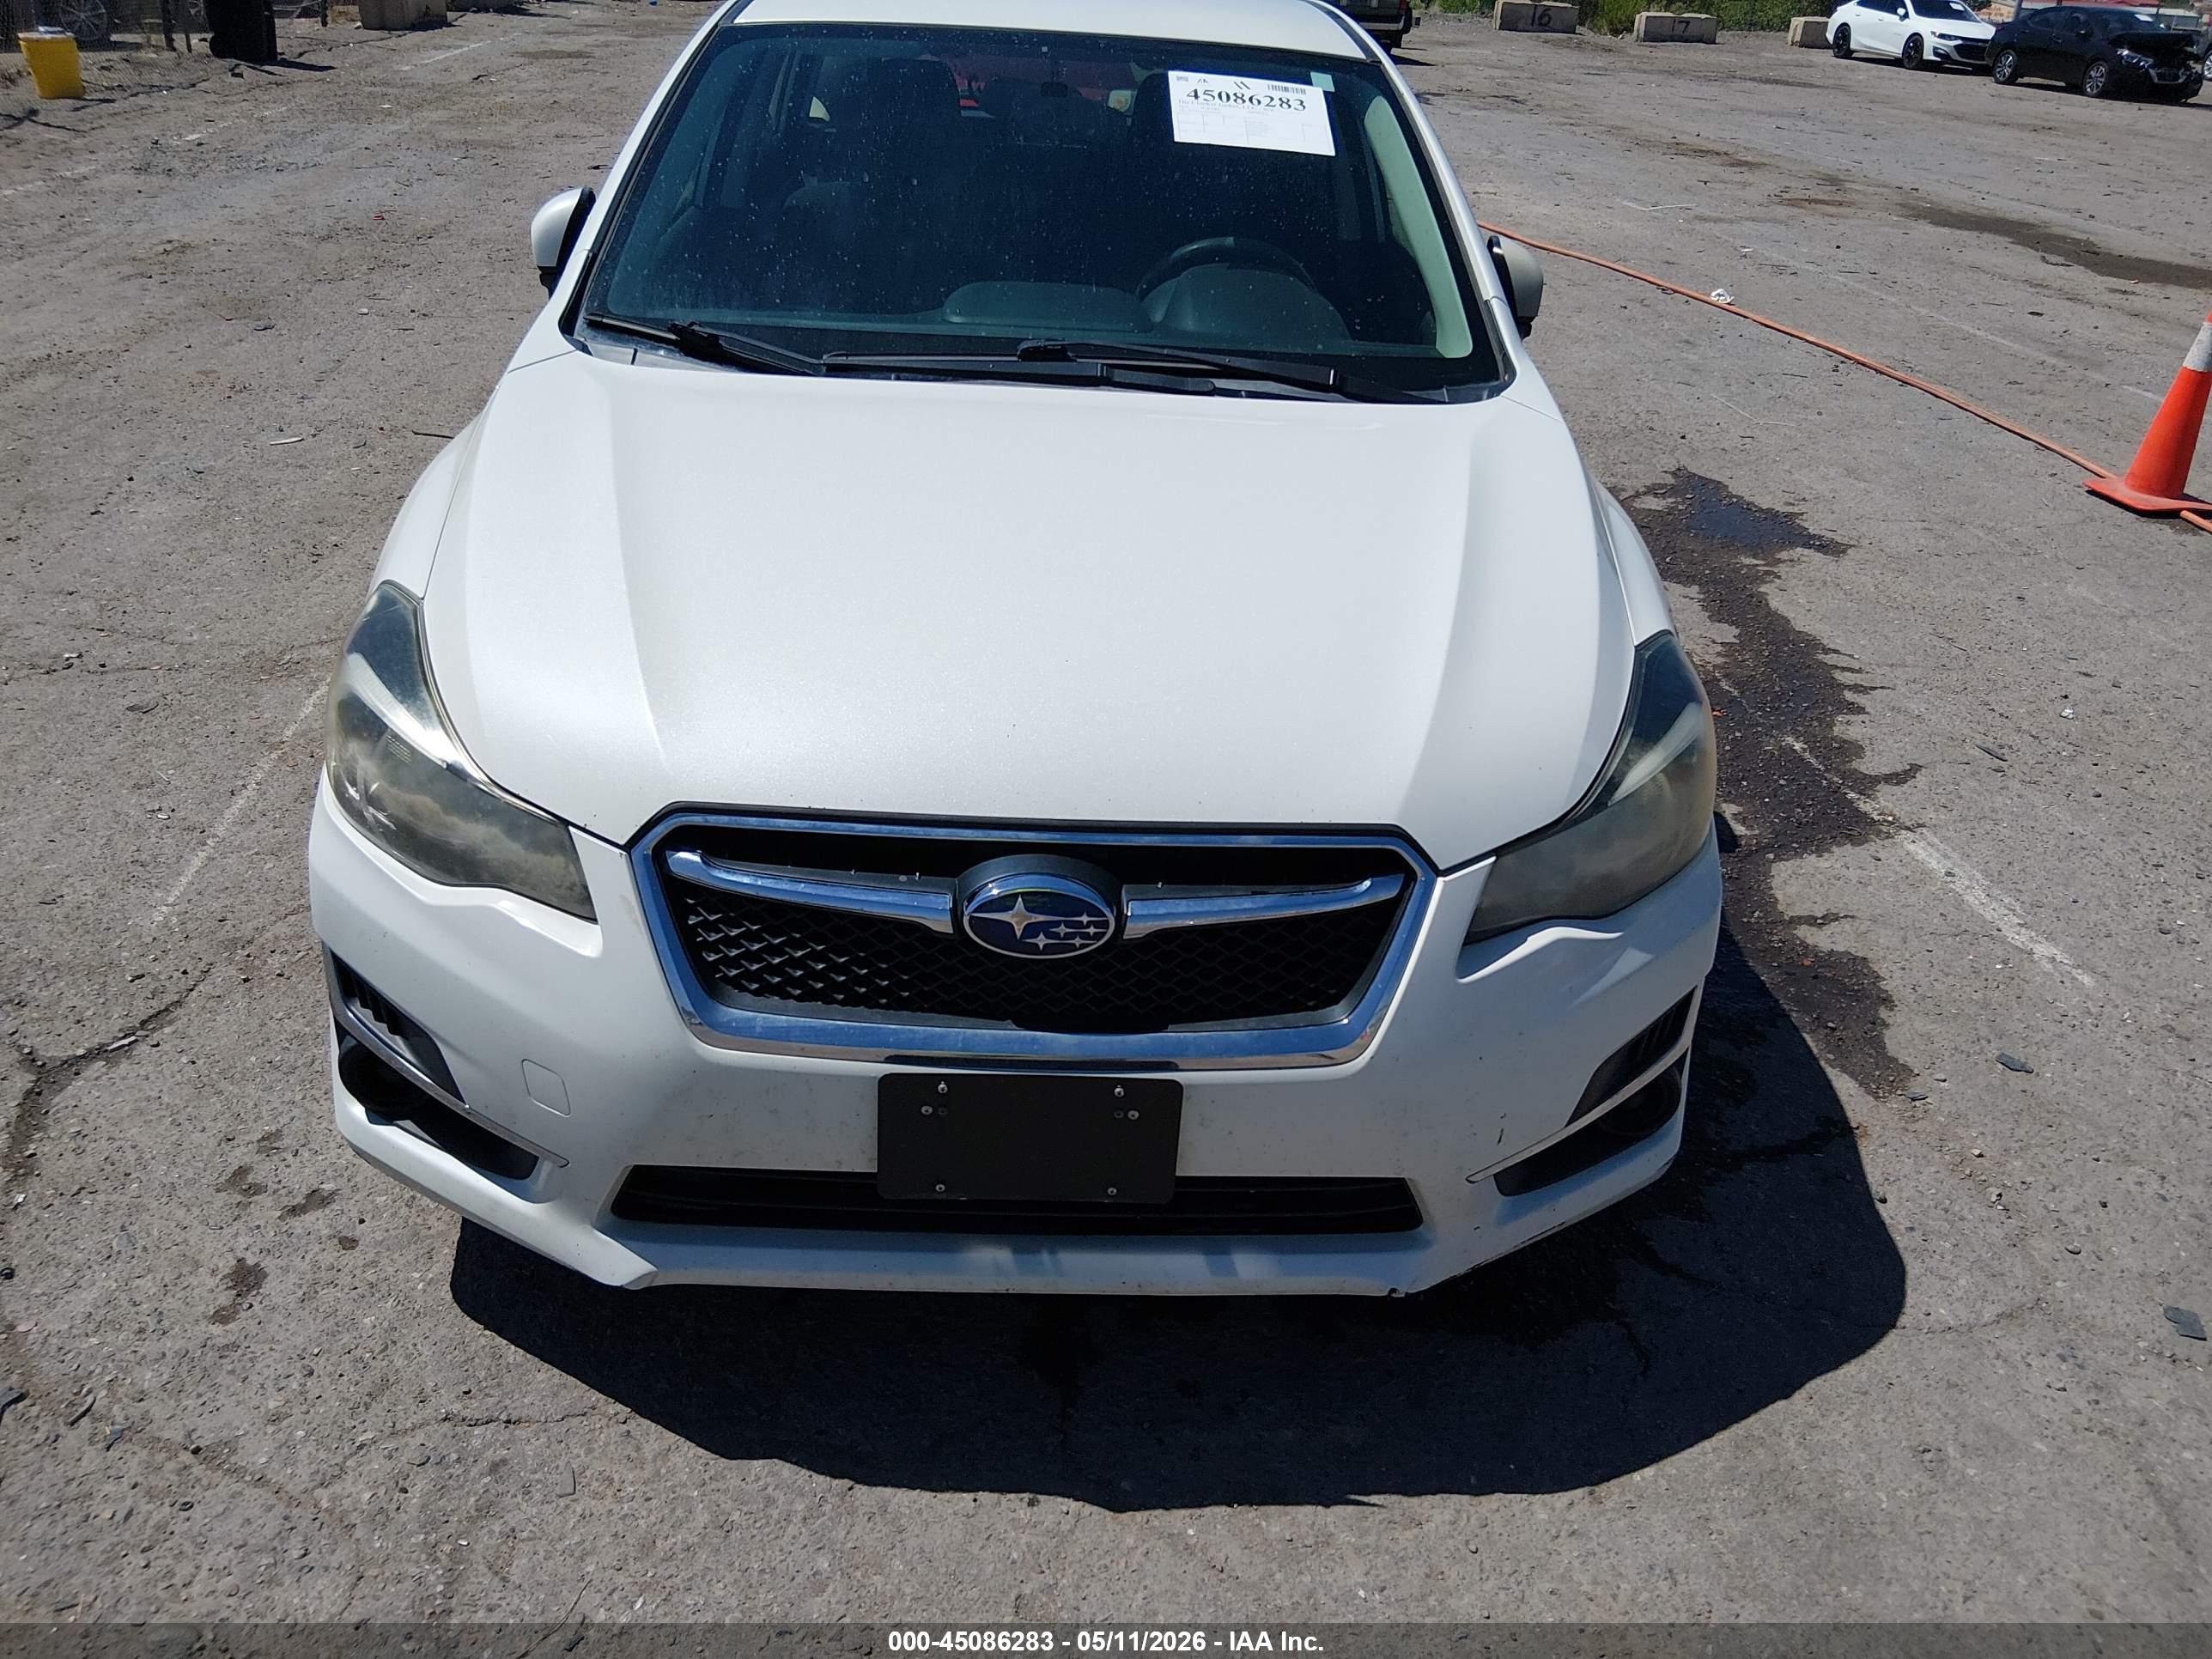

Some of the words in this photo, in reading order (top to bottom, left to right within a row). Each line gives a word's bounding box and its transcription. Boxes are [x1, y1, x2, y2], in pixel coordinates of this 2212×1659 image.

[1530, 4, 1553, 27] 16
[1671, 18, 1691, 33] 17
[1186, 88, 1307, 112] 45086283
